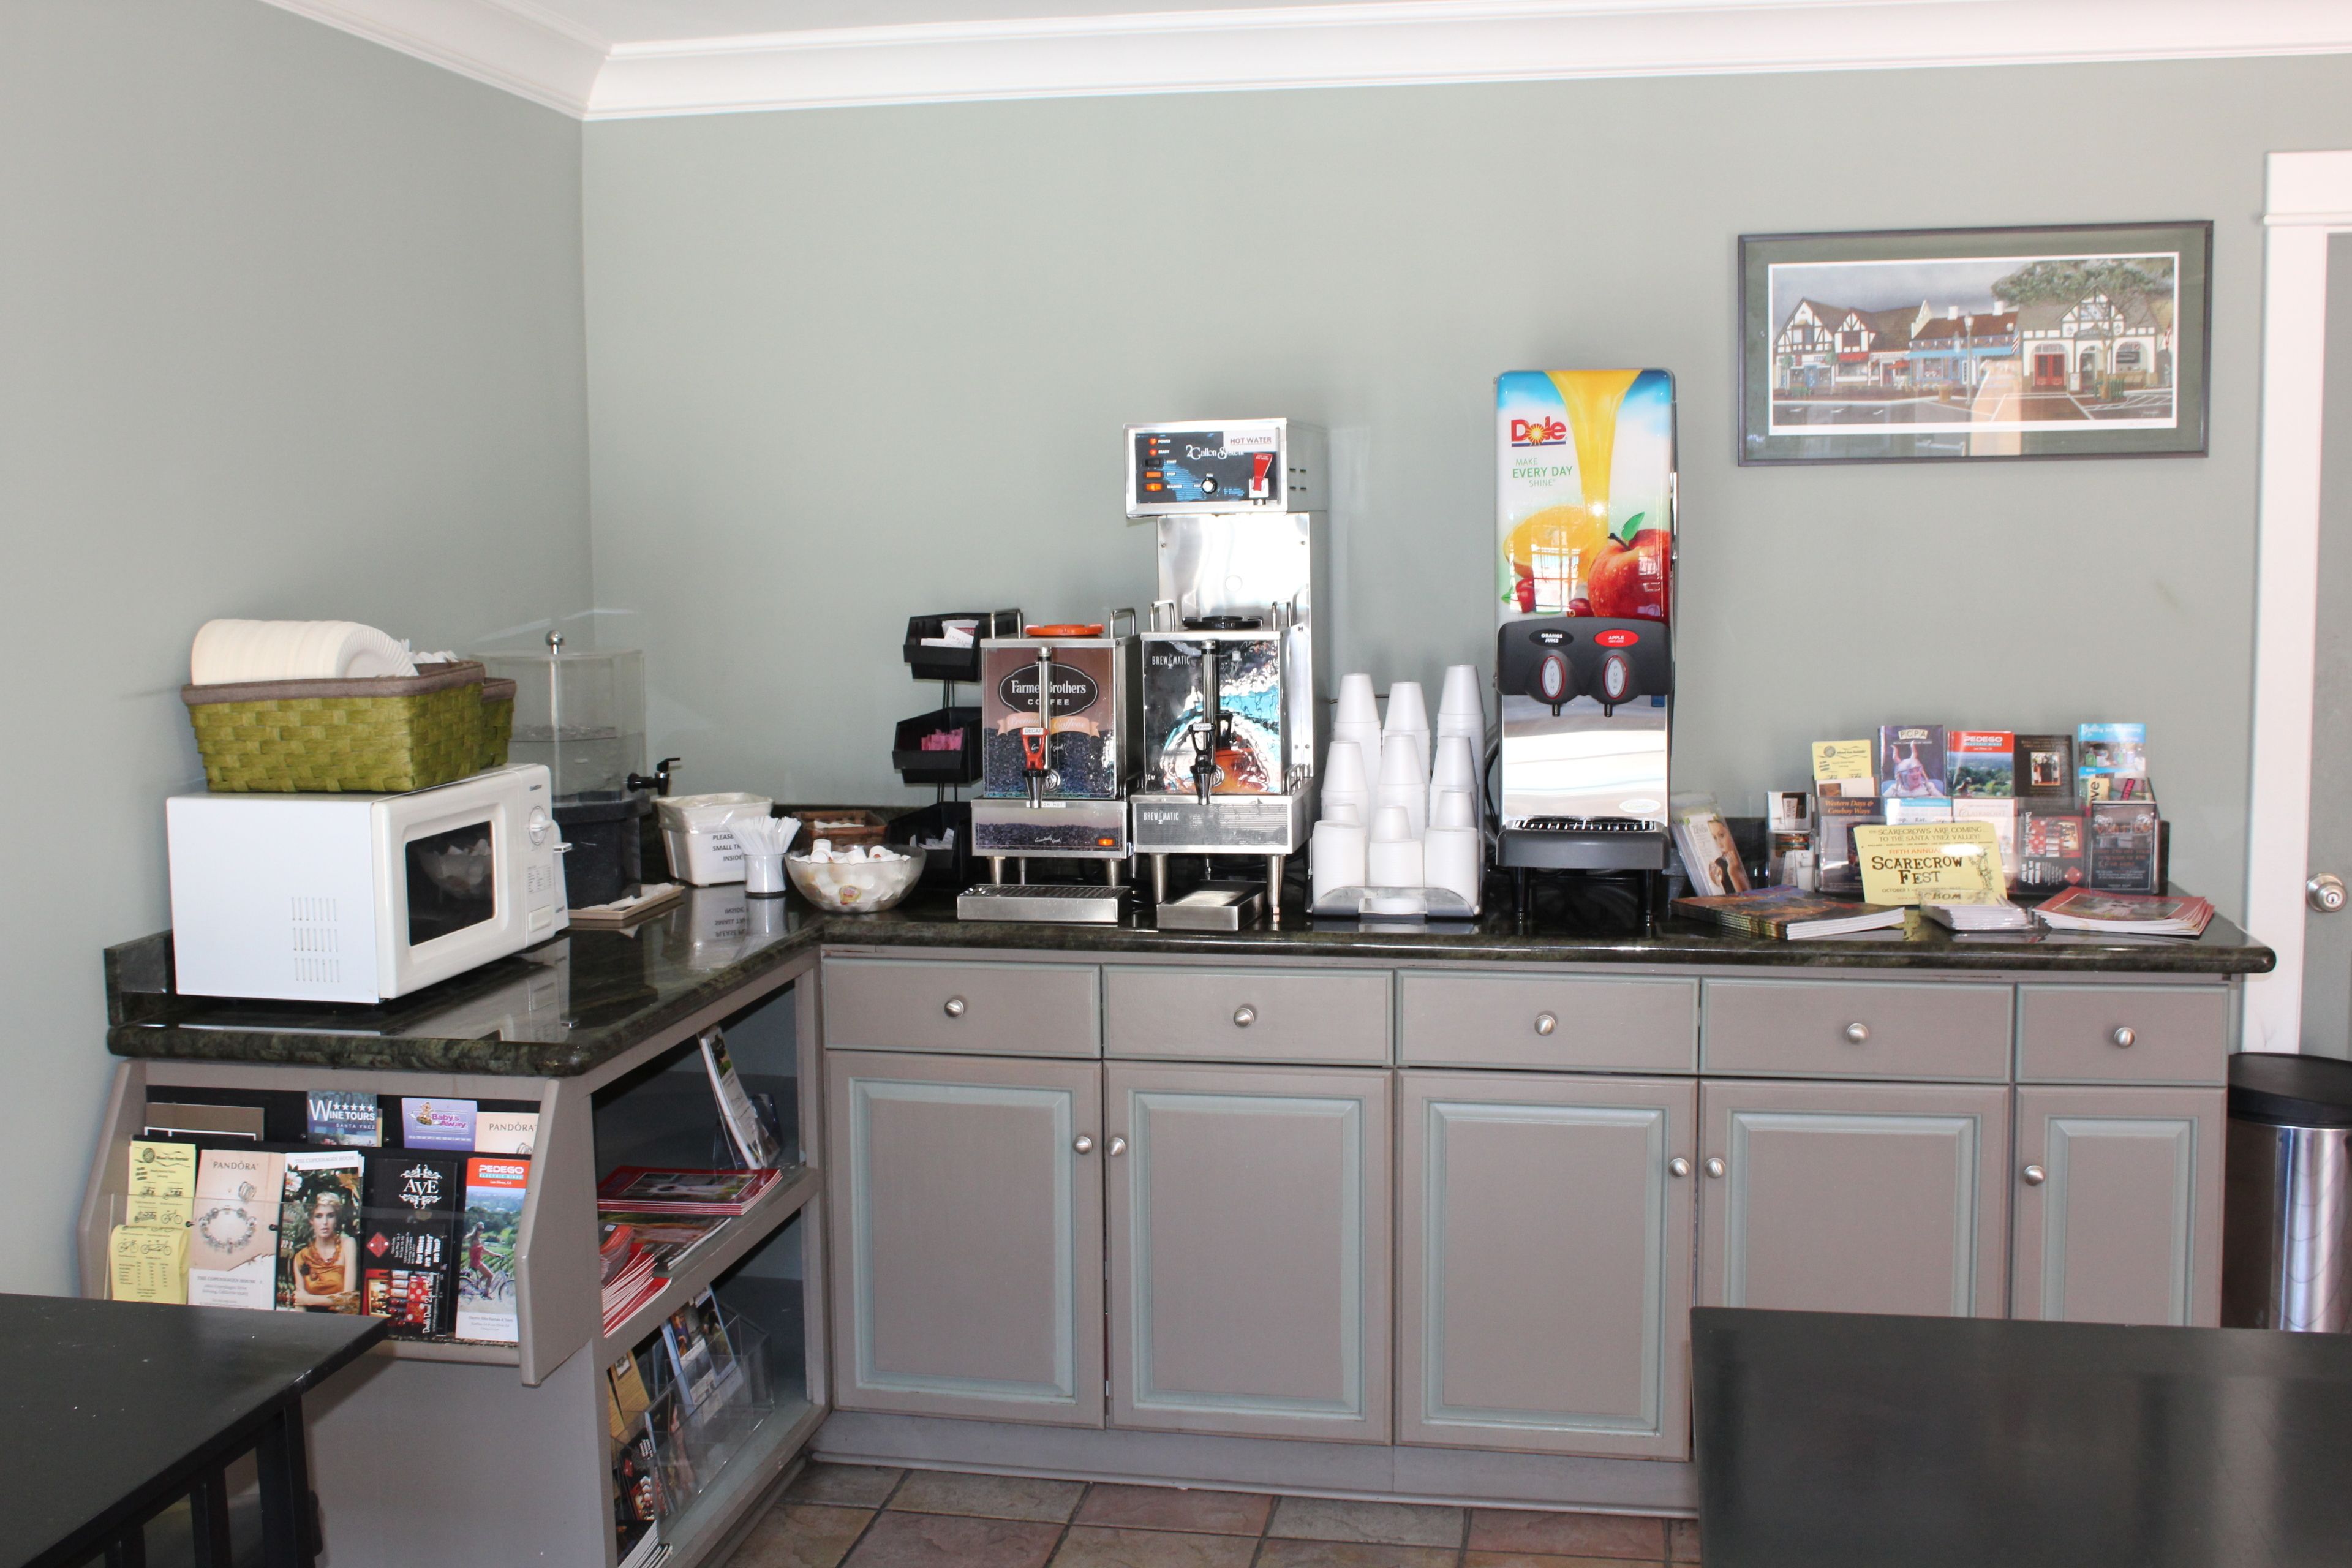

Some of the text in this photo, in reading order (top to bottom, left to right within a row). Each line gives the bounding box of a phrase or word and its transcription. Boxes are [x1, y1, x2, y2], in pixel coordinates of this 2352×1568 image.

[1511, 417, 1566, 445] Dole
[1191, 447, 1216, 460] Gallon
[1512, 466, 1572, 478] EVERY DAY
[1152, 655, 1190, 665] BREW MATIC
[1011, 680, 1039, 693] Farme
[1163, 812, 1179, 820] MATIC
[1872, 856, 1962, 870] SCARECROW
[1898, 870, 1940, 884] FEST
[309, 1099, 375, 1121] WINE TOURS
[479, 1164, 524, 1174] PEDEGO
[402, 1178, 439, 1196] AVE
